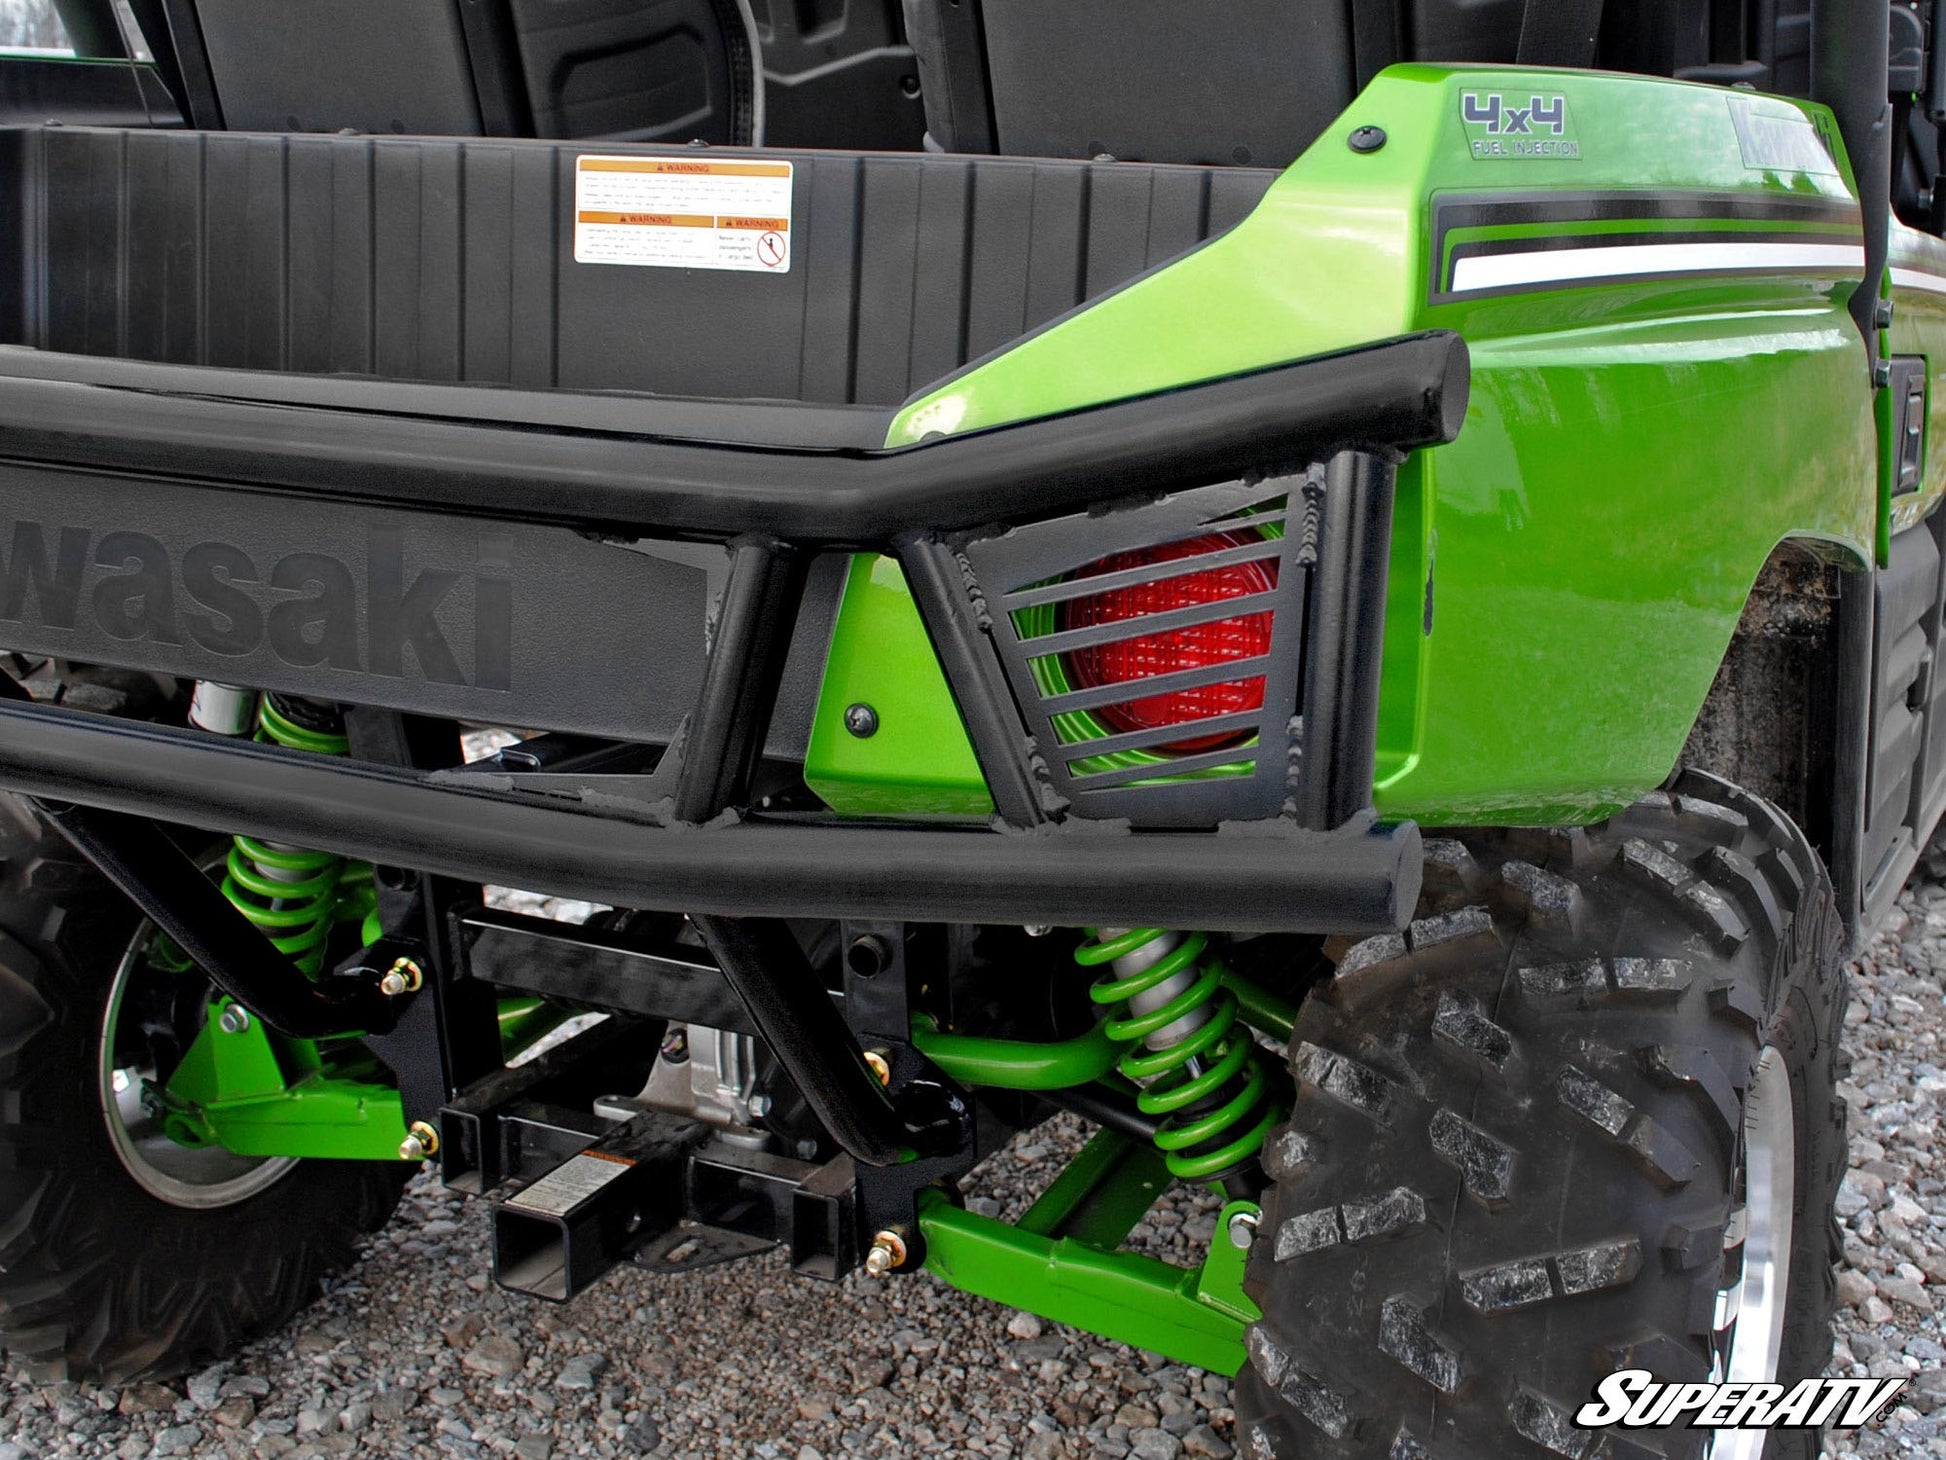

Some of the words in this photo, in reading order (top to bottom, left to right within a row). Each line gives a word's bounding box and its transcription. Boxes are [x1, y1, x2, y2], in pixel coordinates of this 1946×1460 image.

[1463, 94, 1564, 134] 4x4
[1473, 140, 1508, 155] FUEL
[1512, 140, 1578, 156] INJECTION
[666, 162, 710, 173] WARNING
[629, 215, 672, 225] WARNING
[735, 218, 779, 229] WARNING
